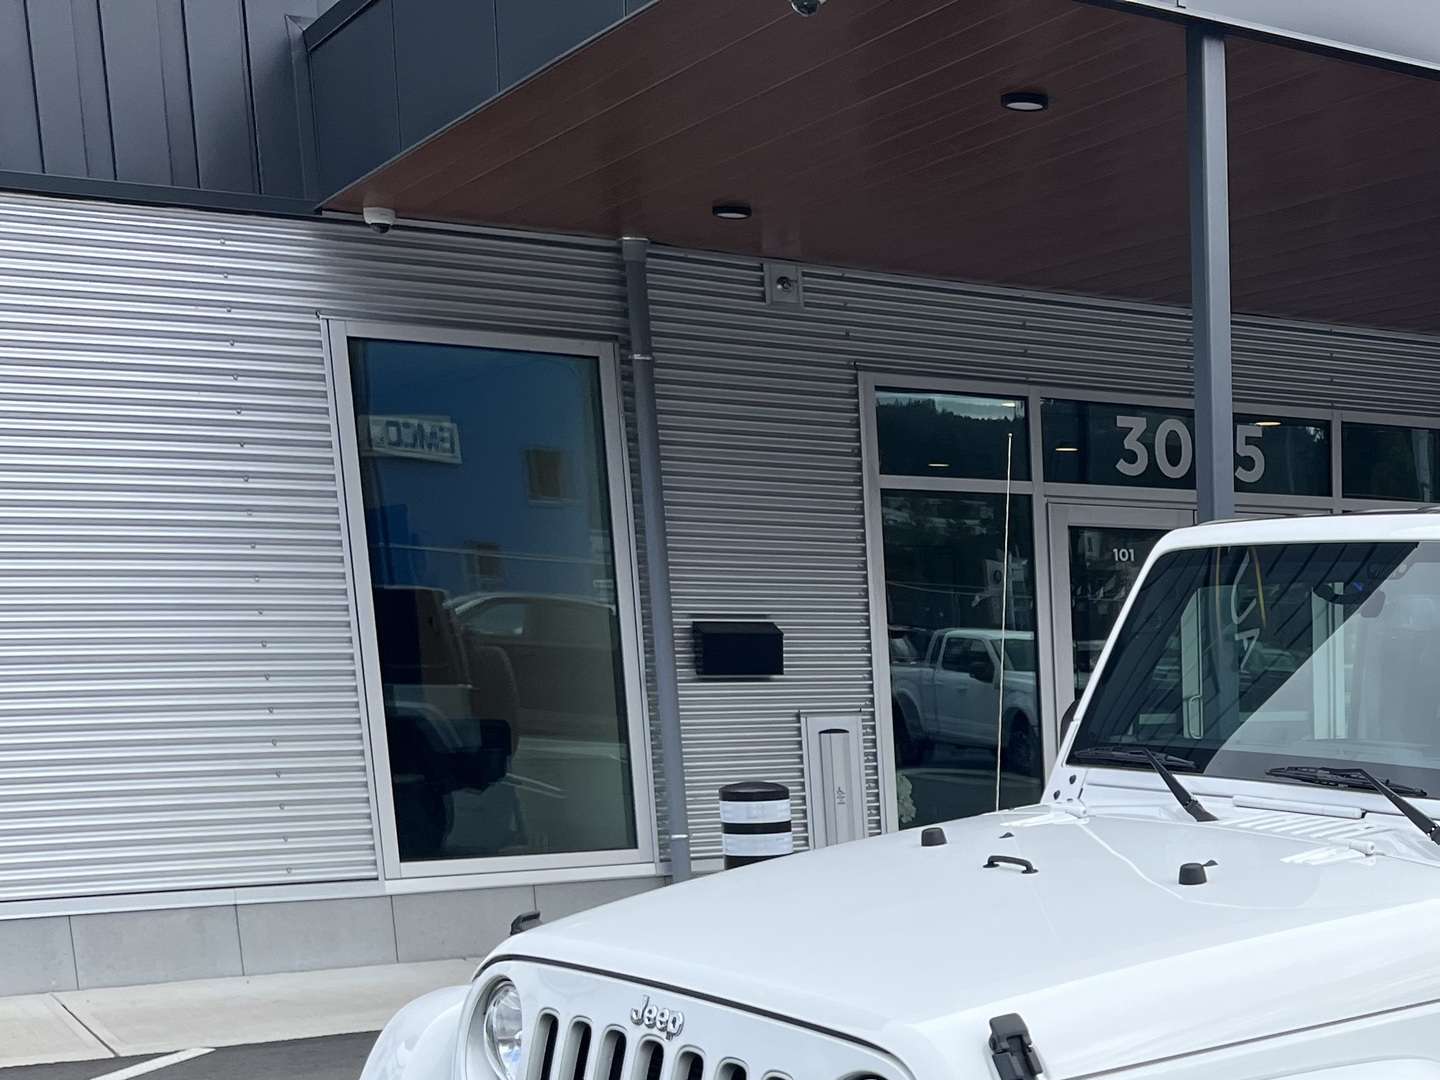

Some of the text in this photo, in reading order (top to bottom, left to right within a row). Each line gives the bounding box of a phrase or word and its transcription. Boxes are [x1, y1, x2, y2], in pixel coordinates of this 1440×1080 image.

[1115, 415, 1265, 484] 305
[1113, 548, 1135, 562] 101
[631, 994, 685, 1041] Jeep
